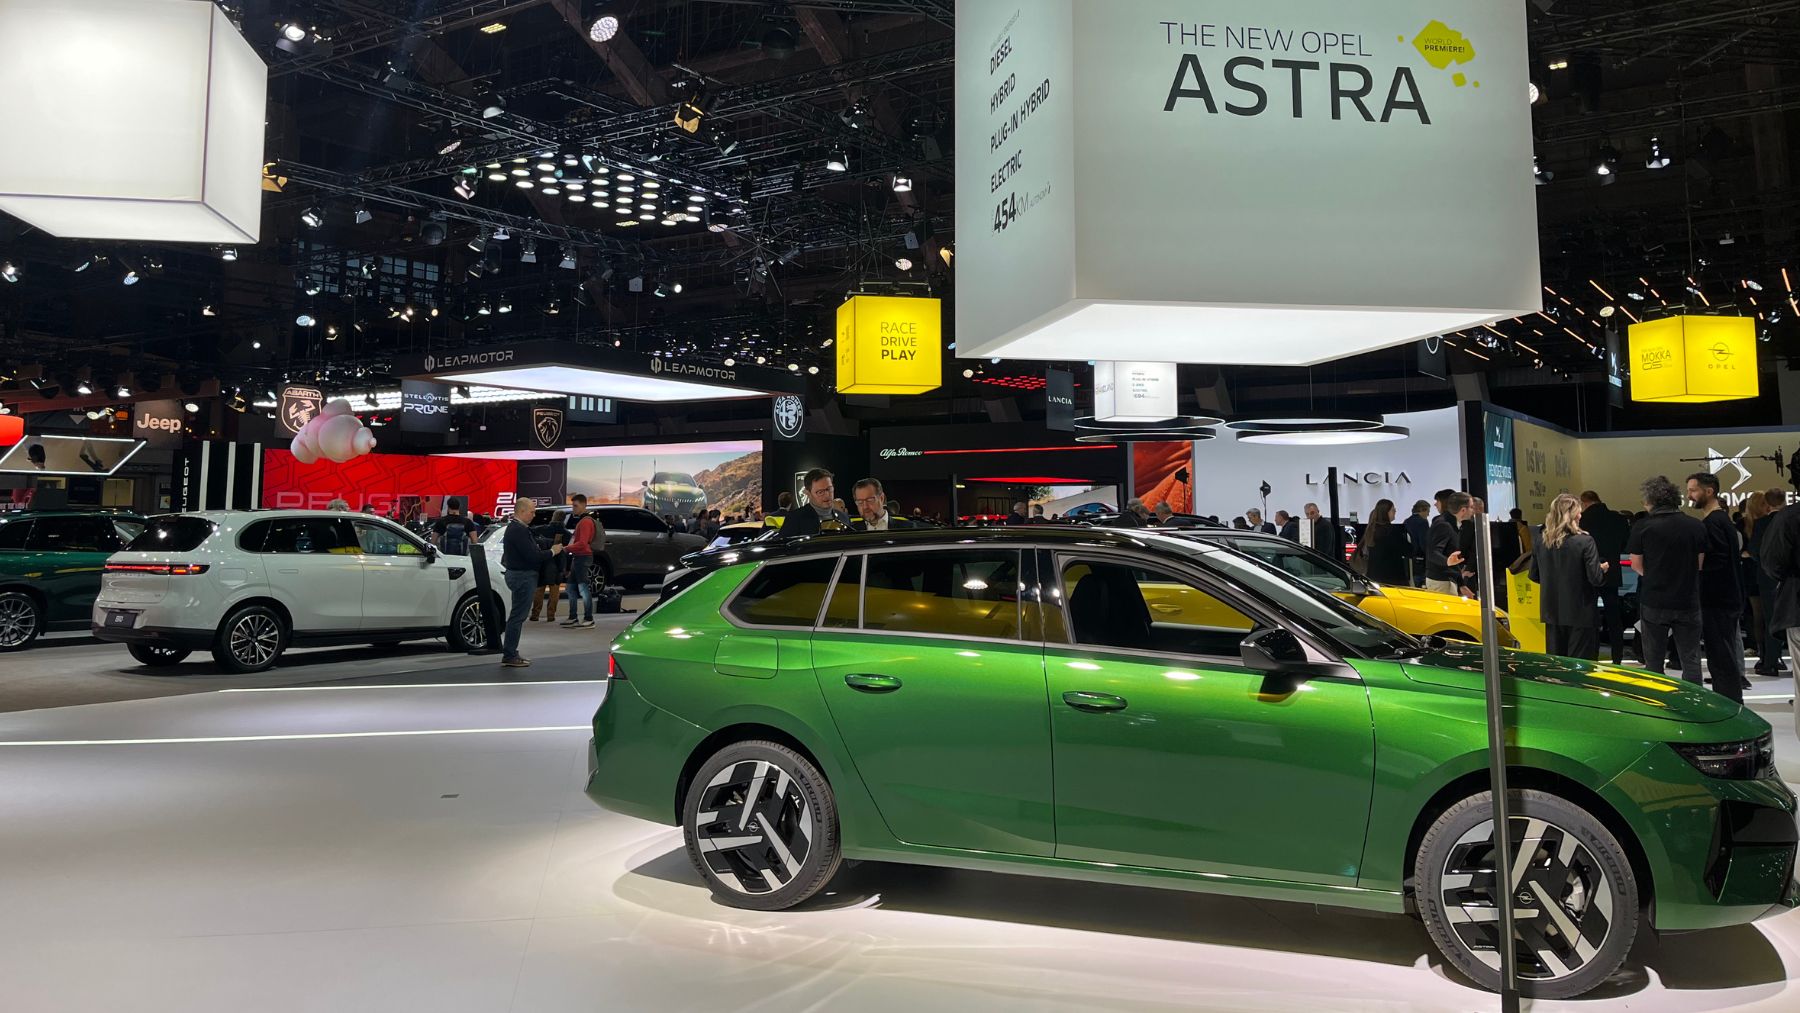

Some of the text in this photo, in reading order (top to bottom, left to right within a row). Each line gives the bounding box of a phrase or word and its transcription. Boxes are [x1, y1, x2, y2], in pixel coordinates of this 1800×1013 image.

[1159, 21, 1373, 57] THE NEW OPEL
[1424, 37, 1453, 46] WORLD
[990, 35, 1013, 76] DIESEL
[1424, 44, 1465, 53] PREMIERE!
[990, 72, 1016, 115] HYBRID
[1163, 53, 1432, 125] ASTRA
[990, 78, 1050, 155] PLUG-IN HYBRID
[991, 149, 1022, 194] ELECTRIC
[880, 321, 917, 335] RACE
[880, 336, 918, 347] DRIVE
[437, 350, 514, 368] LEAPMOTOR
[881, 349, 917, 361] PLAY
[1641, 350, 1672, 363] MOKKA
[664, 363, 736, 381] LEAPMOTOR
[404, 393, 449, 402] STELLANTIS
[1048, 395, 1073, 405] LANCIA
[136, 413, 182, 434] Jeep
[879, 447, 923, 460] Alfa Romeo
